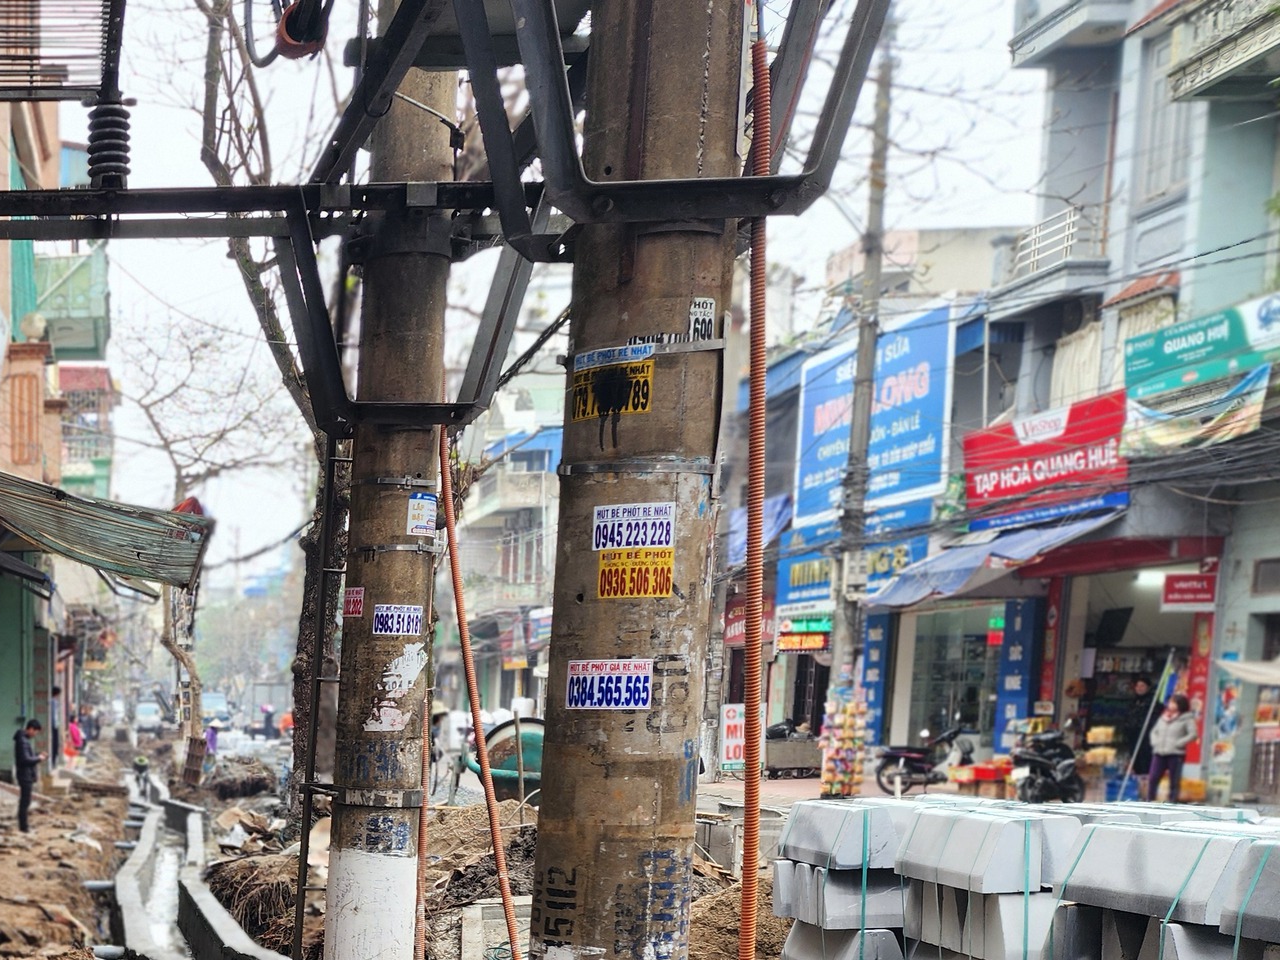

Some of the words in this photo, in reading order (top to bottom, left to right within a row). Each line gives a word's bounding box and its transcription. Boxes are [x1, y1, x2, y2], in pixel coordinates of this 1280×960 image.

[974, 471, 999, 498] TẠP
[1033, 450, 1085, 481] QUANG
[597, 507, 609, 519] HÚT
[622, 504, 640, 517] PHỐT
[653, 504, 672, 516] NHẤT
[595, 521, 671, 549] 0945.223.228
[602, 551, 623, 561] HÚT
[645, 549, 673, 559] PHỐT
[600, 567, 672, 597] 0936.506.306
[591, 661, 608, 672] PHỐT
[568, 675, 650, 707] 0384.565.565
